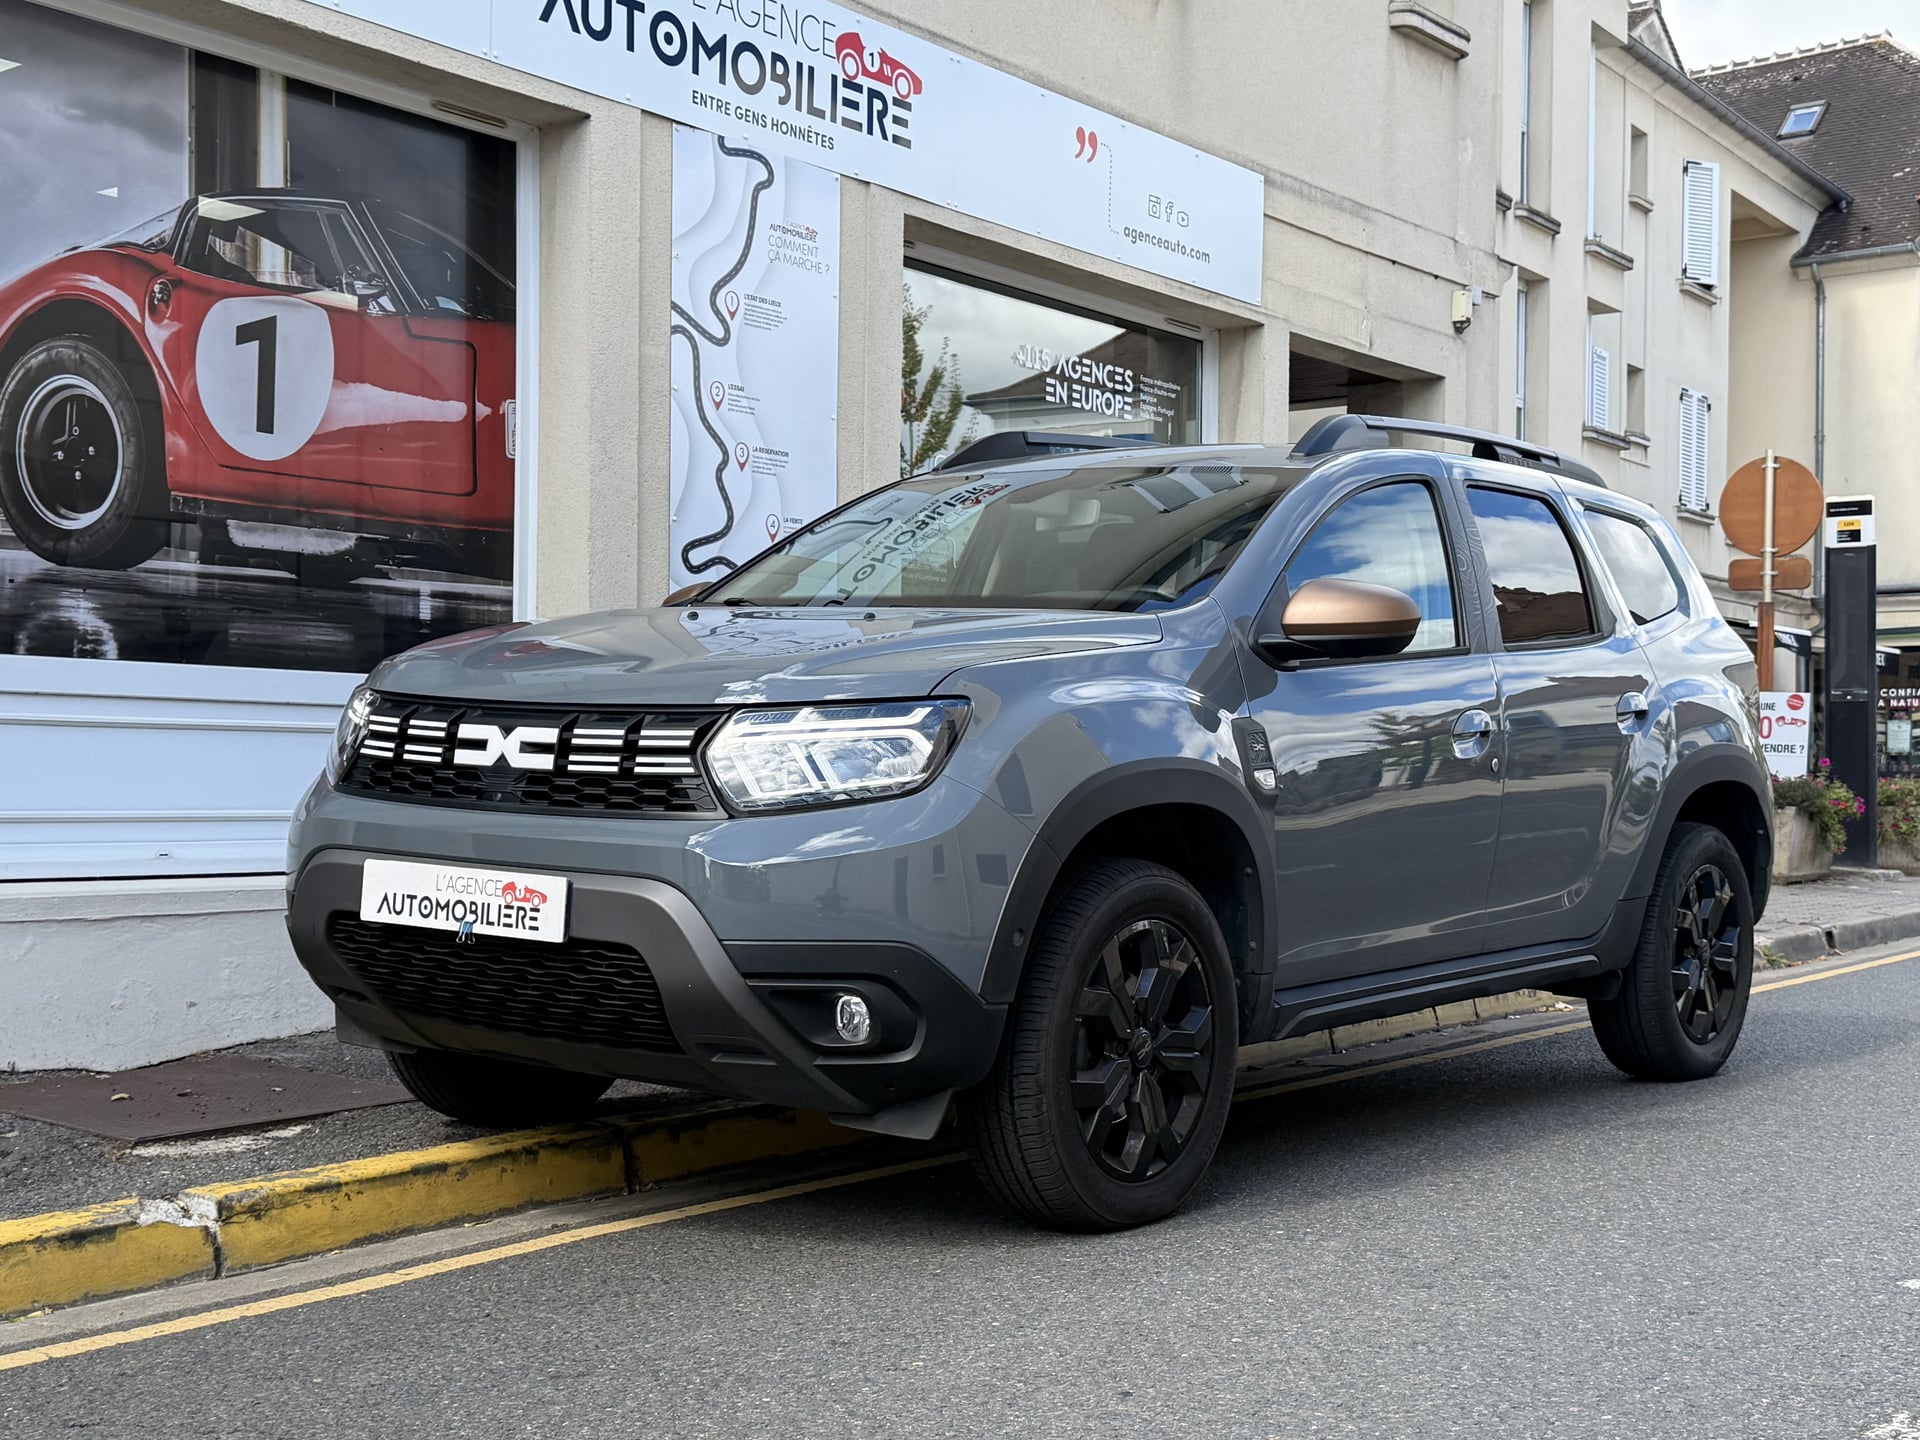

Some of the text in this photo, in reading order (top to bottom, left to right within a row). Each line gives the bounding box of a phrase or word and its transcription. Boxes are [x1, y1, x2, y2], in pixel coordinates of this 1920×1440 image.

[692, 0, 837, 60] AGENCE
[692, 89, 835, 151] ENTRE GENS HONNÊTES
[768, 234, 819, 258] COMMENT
[1123, 225, 1211, 264] agenceauto.com
[768, 248, 830, 274] ÇA MARCHE ?
[234, 314, 278, 435] 1
[1056, 354, 1134, 392] AGENCES
[715, 387, 721, 397] 2
[1046, 377, 1133, 420] EN EUROPE
[739, 447, 745, 458] 3
[769, 519, 776, 529] 4
[1760, 702, 1776, 711] UNE
[1799, 744, 1805, 754] ?
[436, 873, 503, 898] L'AGENCE
